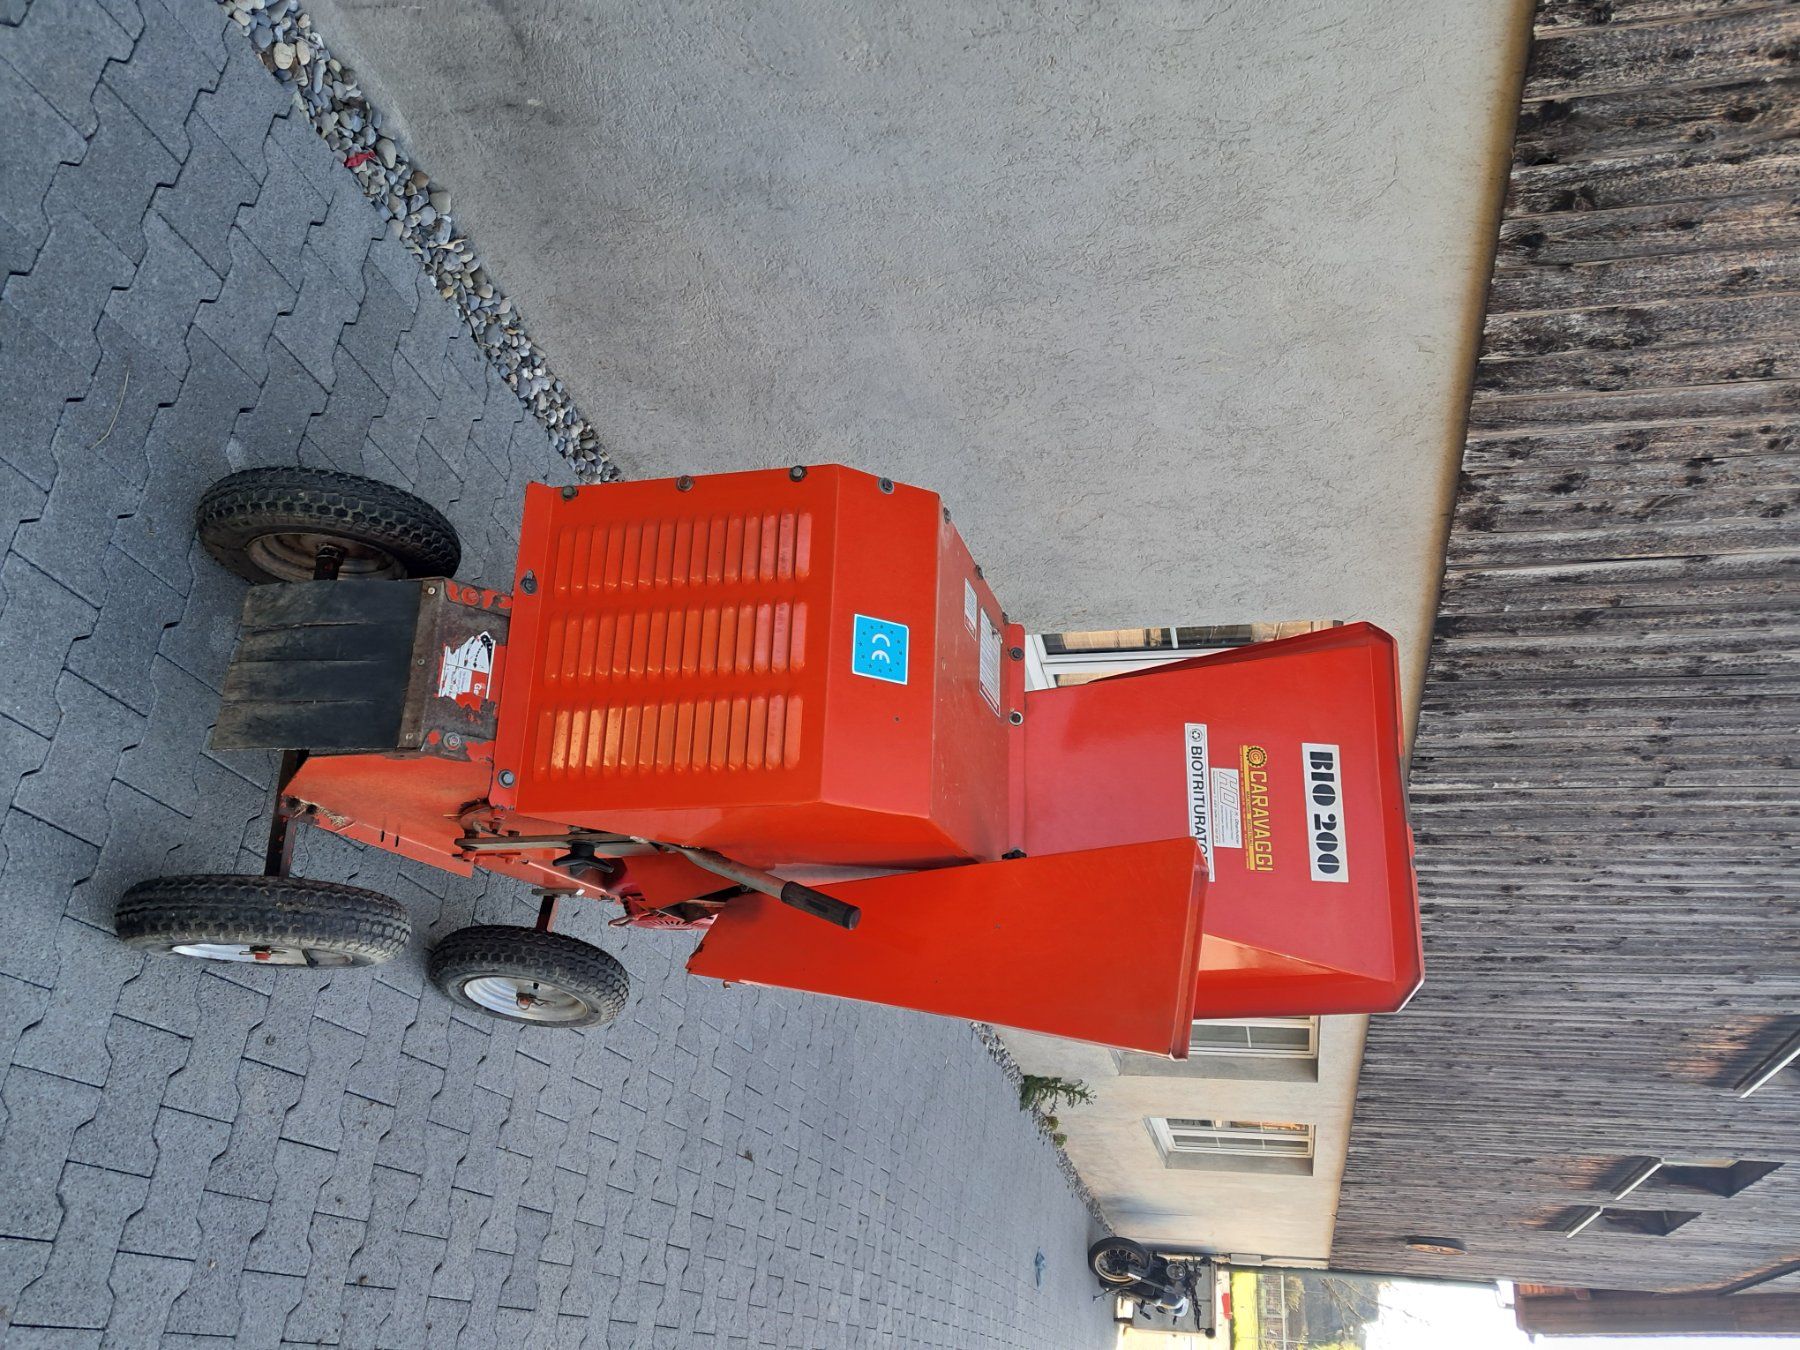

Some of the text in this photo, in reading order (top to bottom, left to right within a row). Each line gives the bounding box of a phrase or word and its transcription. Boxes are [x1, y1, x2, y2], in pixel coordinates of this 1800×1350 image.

[1190, 745, 1208, 861] BIOTRITURATO
[1249, 770, 1274, 871] CARAVAGGI
[1309, 751, 1340, 874] BIO 200
